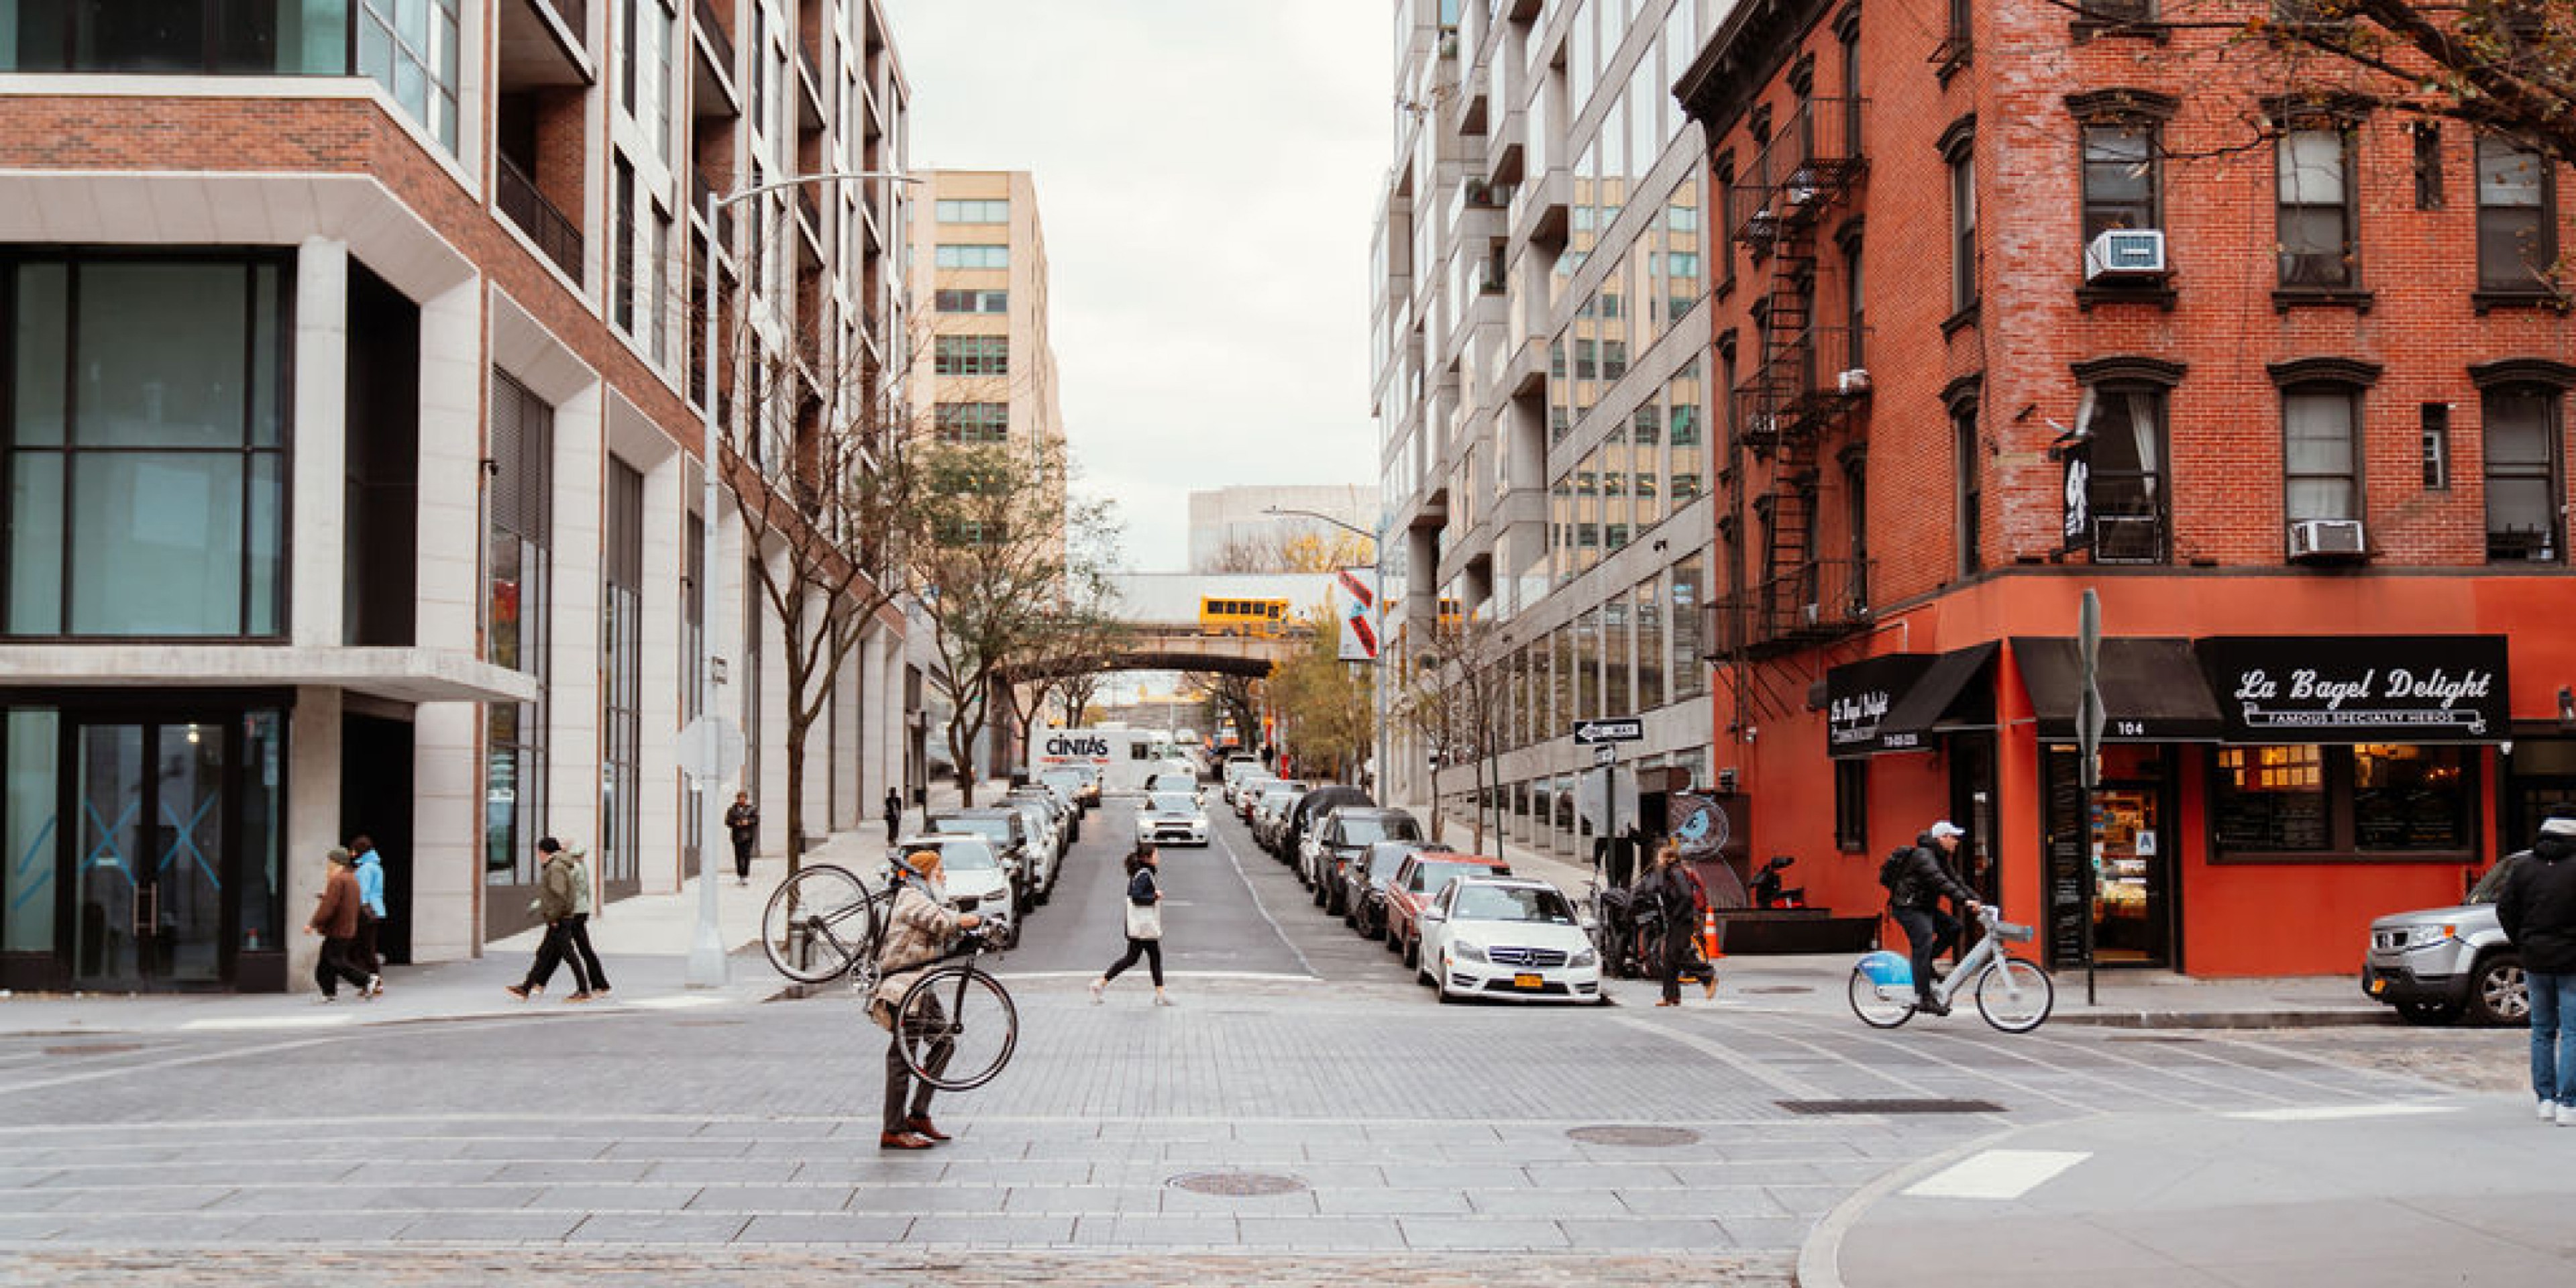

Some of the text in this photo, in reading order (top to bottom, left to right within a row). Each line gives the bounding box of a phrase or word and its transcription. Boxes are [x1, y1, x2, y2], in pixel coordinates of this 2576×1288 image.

[2235, 668, 2491, 710] La Bagel Delight
[2269, 712, 2327, 725] FAMOUS
[2332, 712, 2406, 724] SPECIALTY
[1613, 725, 1634, 735] WAY
[2118, 721, 2144, 735] 104
[1046, 732, 1108, 755] CINTAS
[2140, 834, 2152, 849] A
